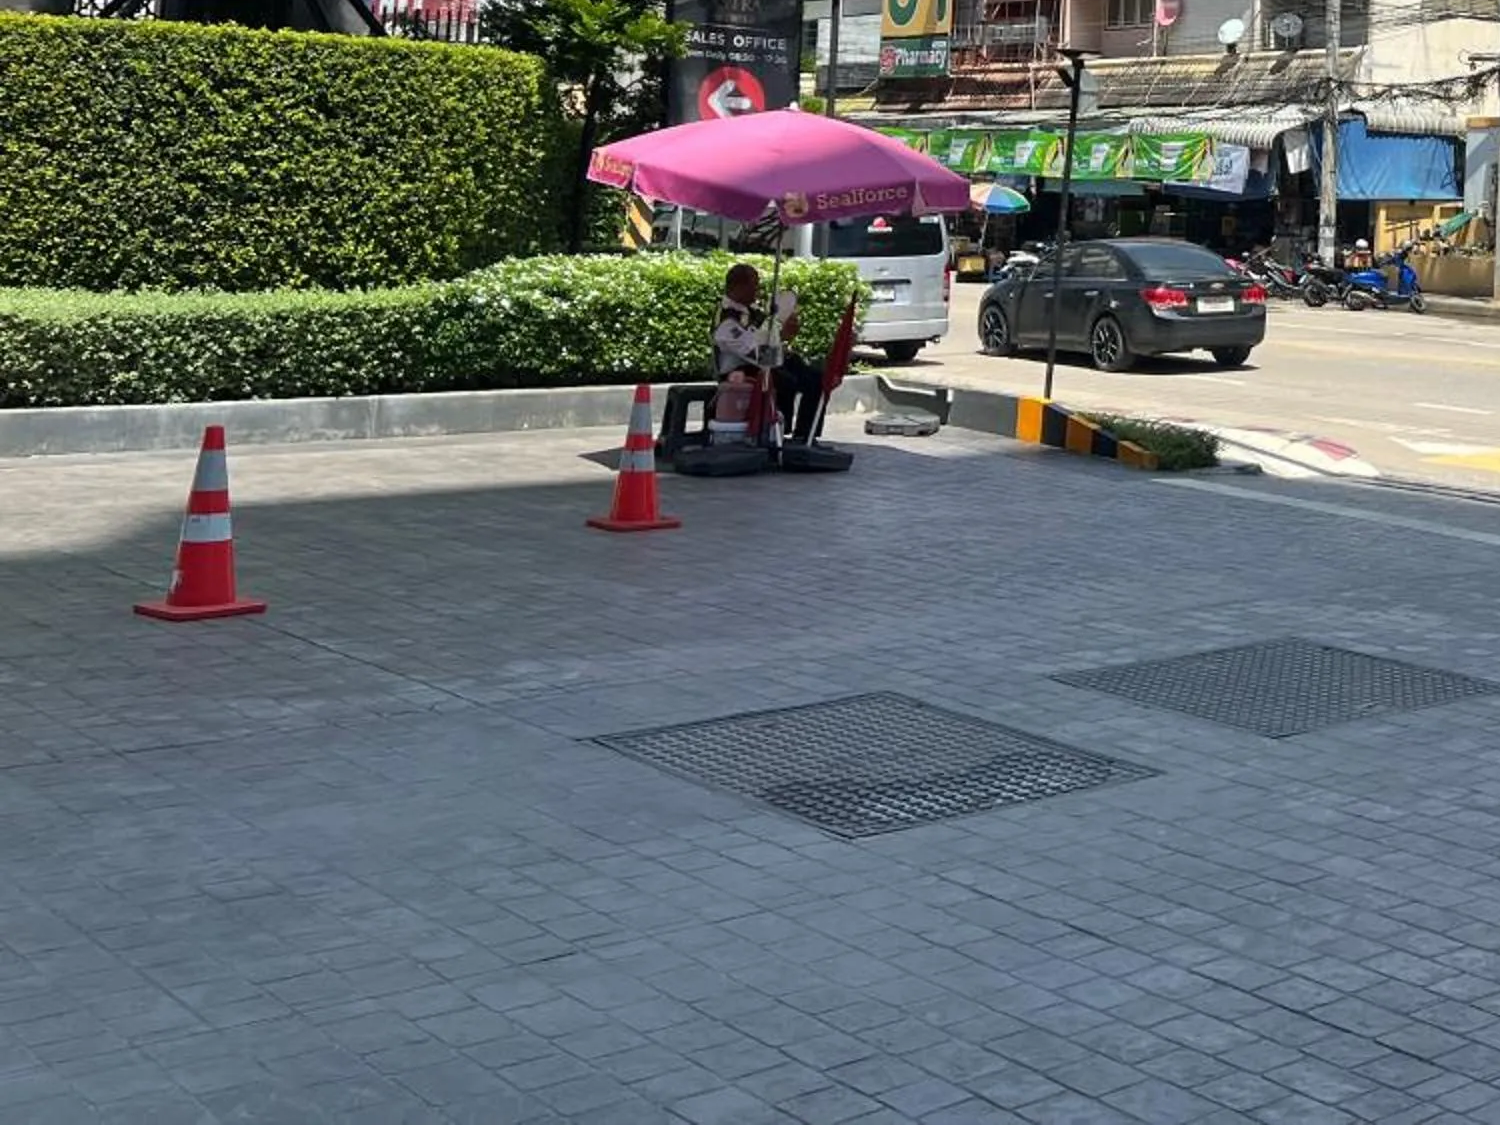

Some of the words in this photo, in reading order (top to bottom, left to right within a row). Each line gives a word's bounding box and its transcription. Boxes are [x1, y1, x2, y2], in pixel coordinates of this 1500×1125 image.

[684, 30, 725, 46] SALES
[733, 34, 787, 51] OFFICE
[895, 48, 947, 70] Pharmacy
[816, 186, 908, 210] Sealforce
